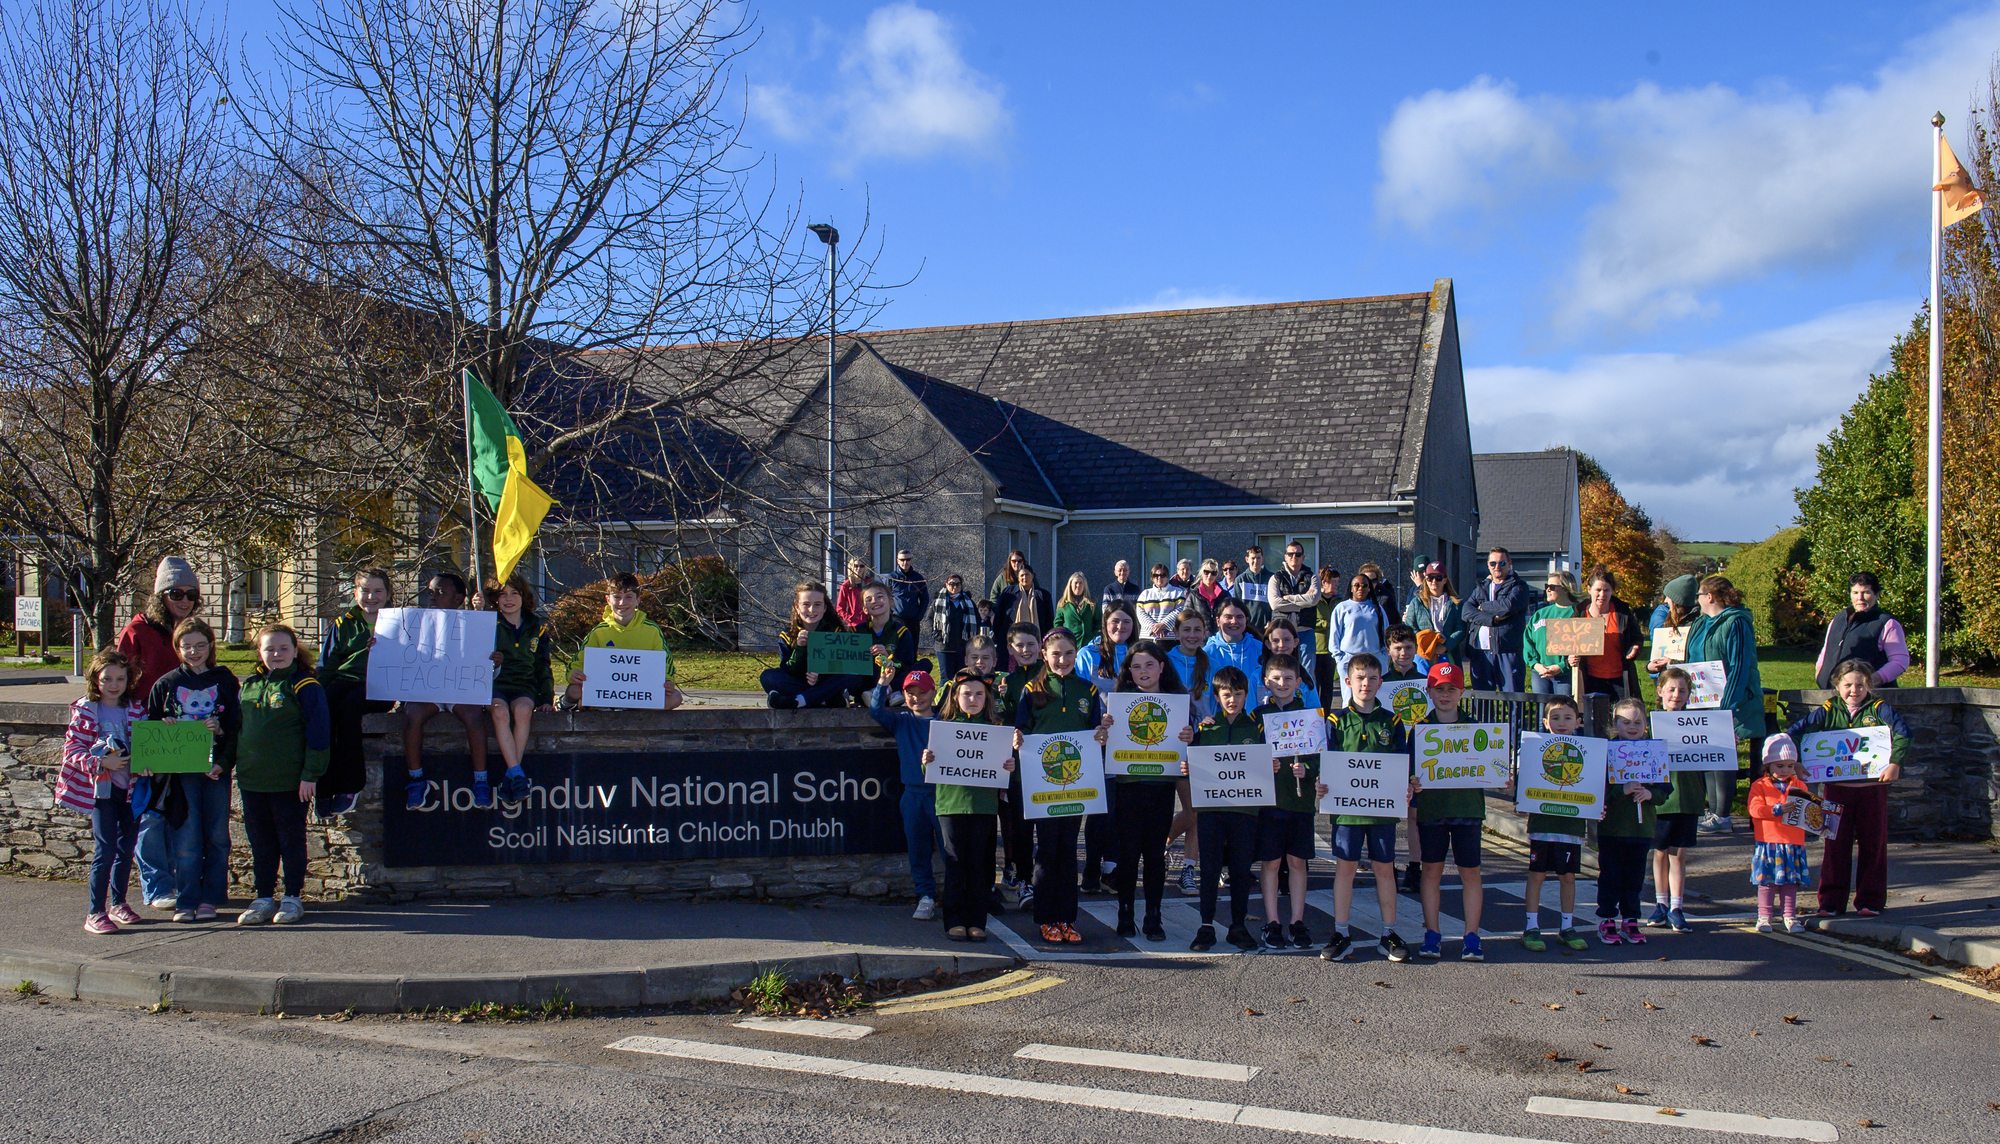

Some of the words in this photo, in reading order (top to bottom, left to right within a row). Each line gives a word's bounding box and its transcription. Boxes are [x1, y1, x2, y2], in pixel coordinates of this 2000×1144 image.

[18, 599, 40, 611] SAVE
[17, 617, 41, 627] TEACHER
[378, 611, 470, 641] SAVE
[824, 633, 860, 646] SAVE
[403, 643, 451, 664] OUR
[609, 654, 641, 665] SAVE
[377, 665, 488, 692] TEACHER
[611, 672, 638, 682] OUR
[1691, 671, 1706, 681] AVE
[595, 689, 653, 701] TEACHER
[1125, 696, 1163, 713] CLOUGHDUV
[1677, 716, 1709, 726] SAVE
[955, 729, 988, 741] SAVE
[1681, 735, 1709, 744] OUR
[1037, 735, 1075, 755] CLOUGHDUV
[1423, 729, 1470, 757] SAVE
[1473, 728, 1505, 751] OUR
[1539, 736, 1579, 753] CLOUGHDUV
[1815, 736, 1870, 758] SAVE
[139, 744, 186, 757] Teacher
[956, 749, 984, 759] OUR
[1214, 752, 1246, 762] SAVE
[1669, 753, 1726, 763] TEACHER
[1347, 758, 1382, 770] SAVE
[1421, 758, 1486, 781] TEACHER
[939, 766, 997, 779] TEACHER
[1218, 770, 1246, 780] OUR
[1806, 762, 1879, 780] TEACHER
[1350, 778, 1379, 789] OUR
[631, 772, 779, 808] National
[1204, 788, 1263, 798] TEACHER
[1333, 796, 1395, 809] TEACHER
[488, 826, 548, 849] Scoil
[557, 823, 670, 847] Náisiúnta
[678, 820, 760, 843] Chloch
[769, 817, 844, 840] Dhubh
[1566, 851, 1571, 863] 7
